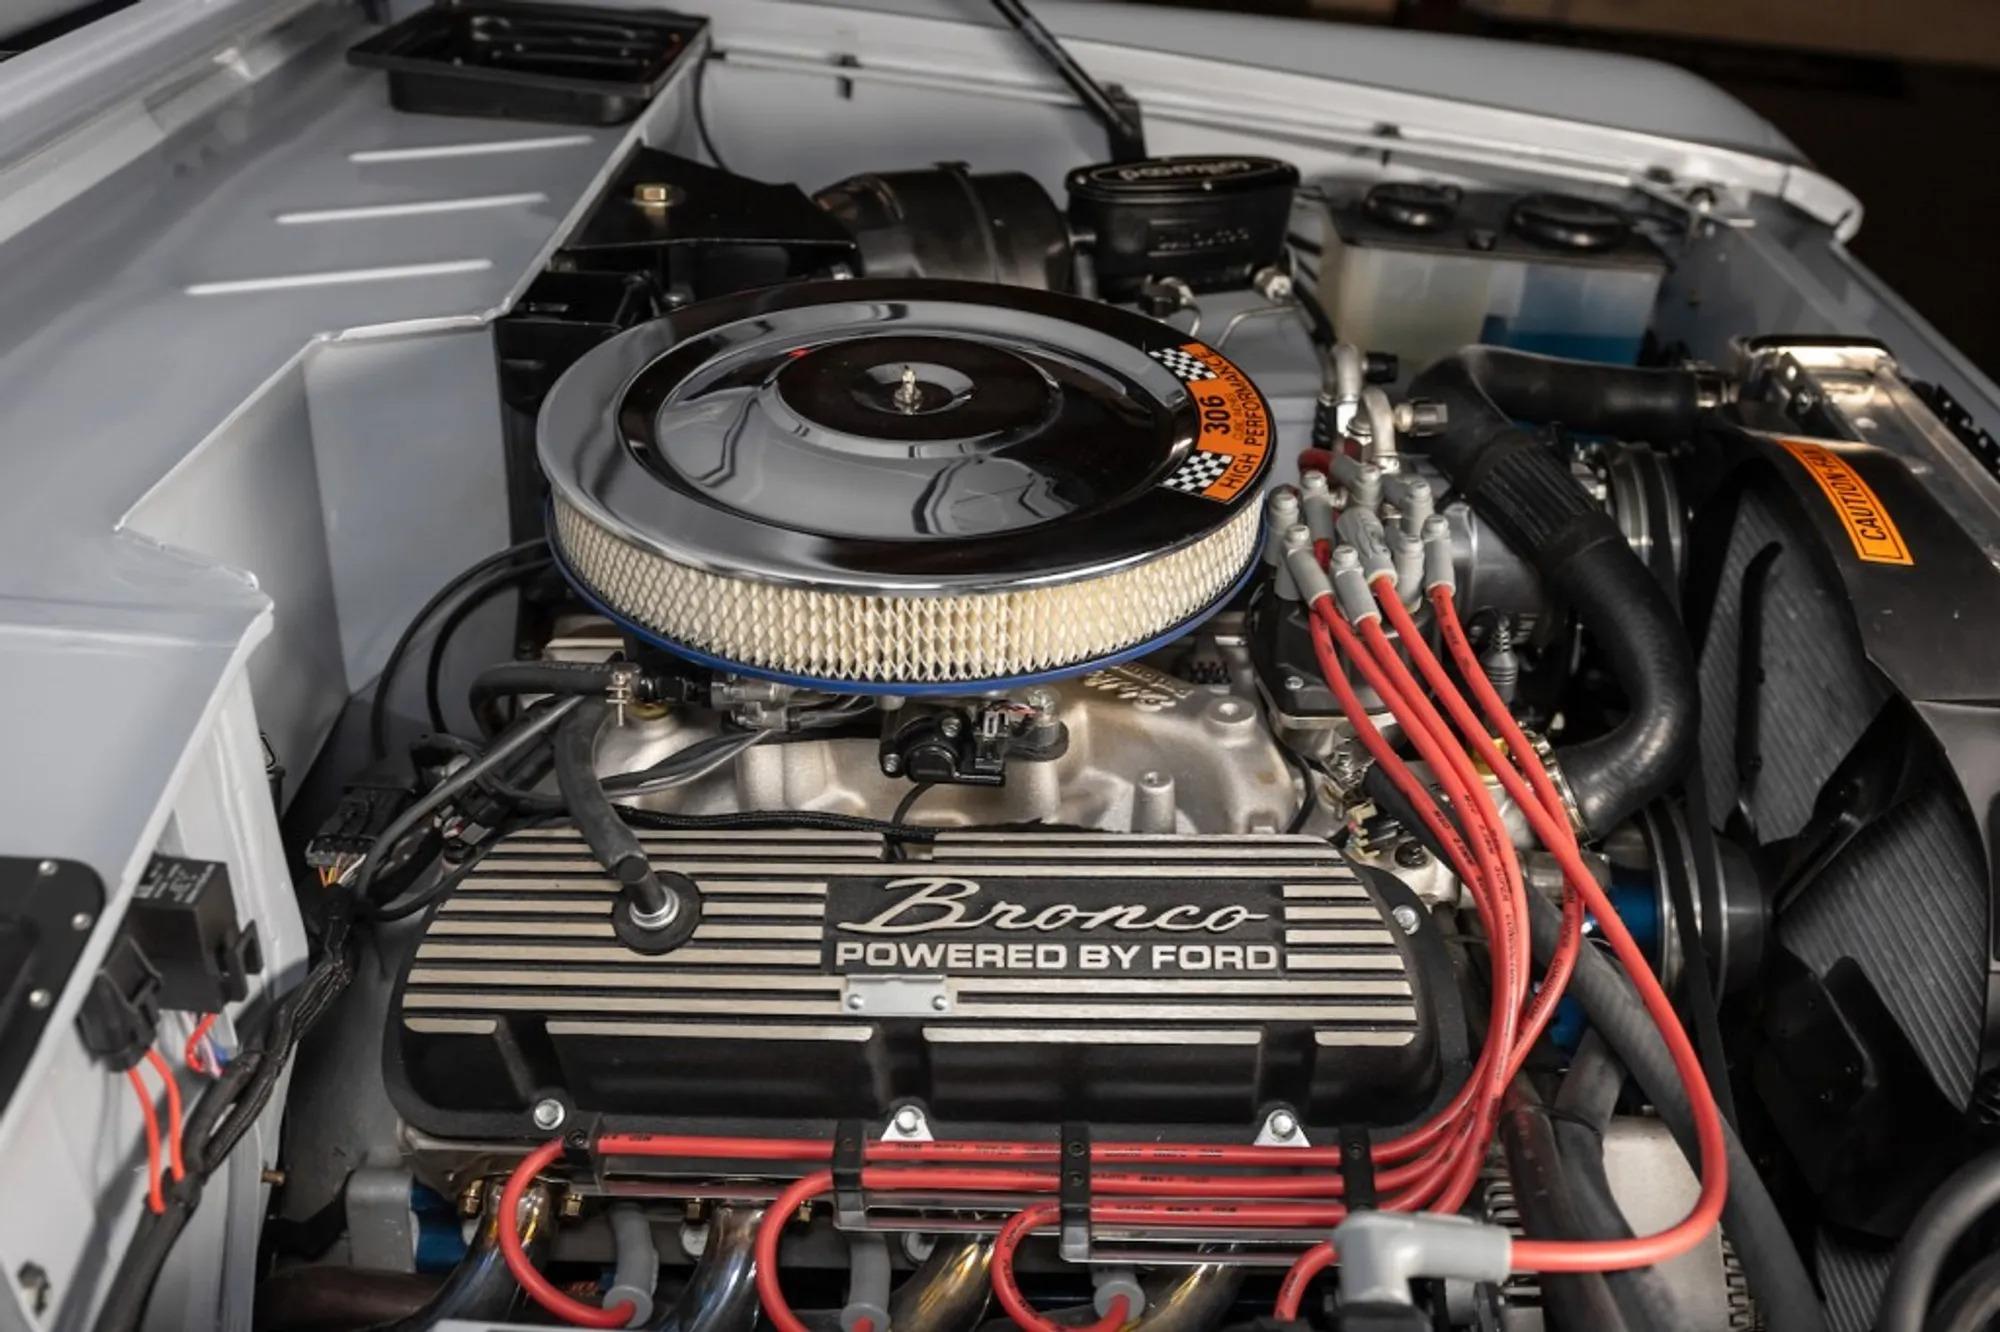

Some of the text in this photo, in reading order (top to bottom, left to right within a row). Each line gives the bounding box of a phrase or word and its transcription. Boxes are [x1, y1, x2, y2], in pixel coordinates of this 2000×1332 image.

[1197, 350, 1265, 489] HIGH PERFORMANCE
[1199, 395, 1231, 435] 306
[836, 877, 1270, 934] Bronco
[836, 942, 1278, 970] POWERED BY FORD
